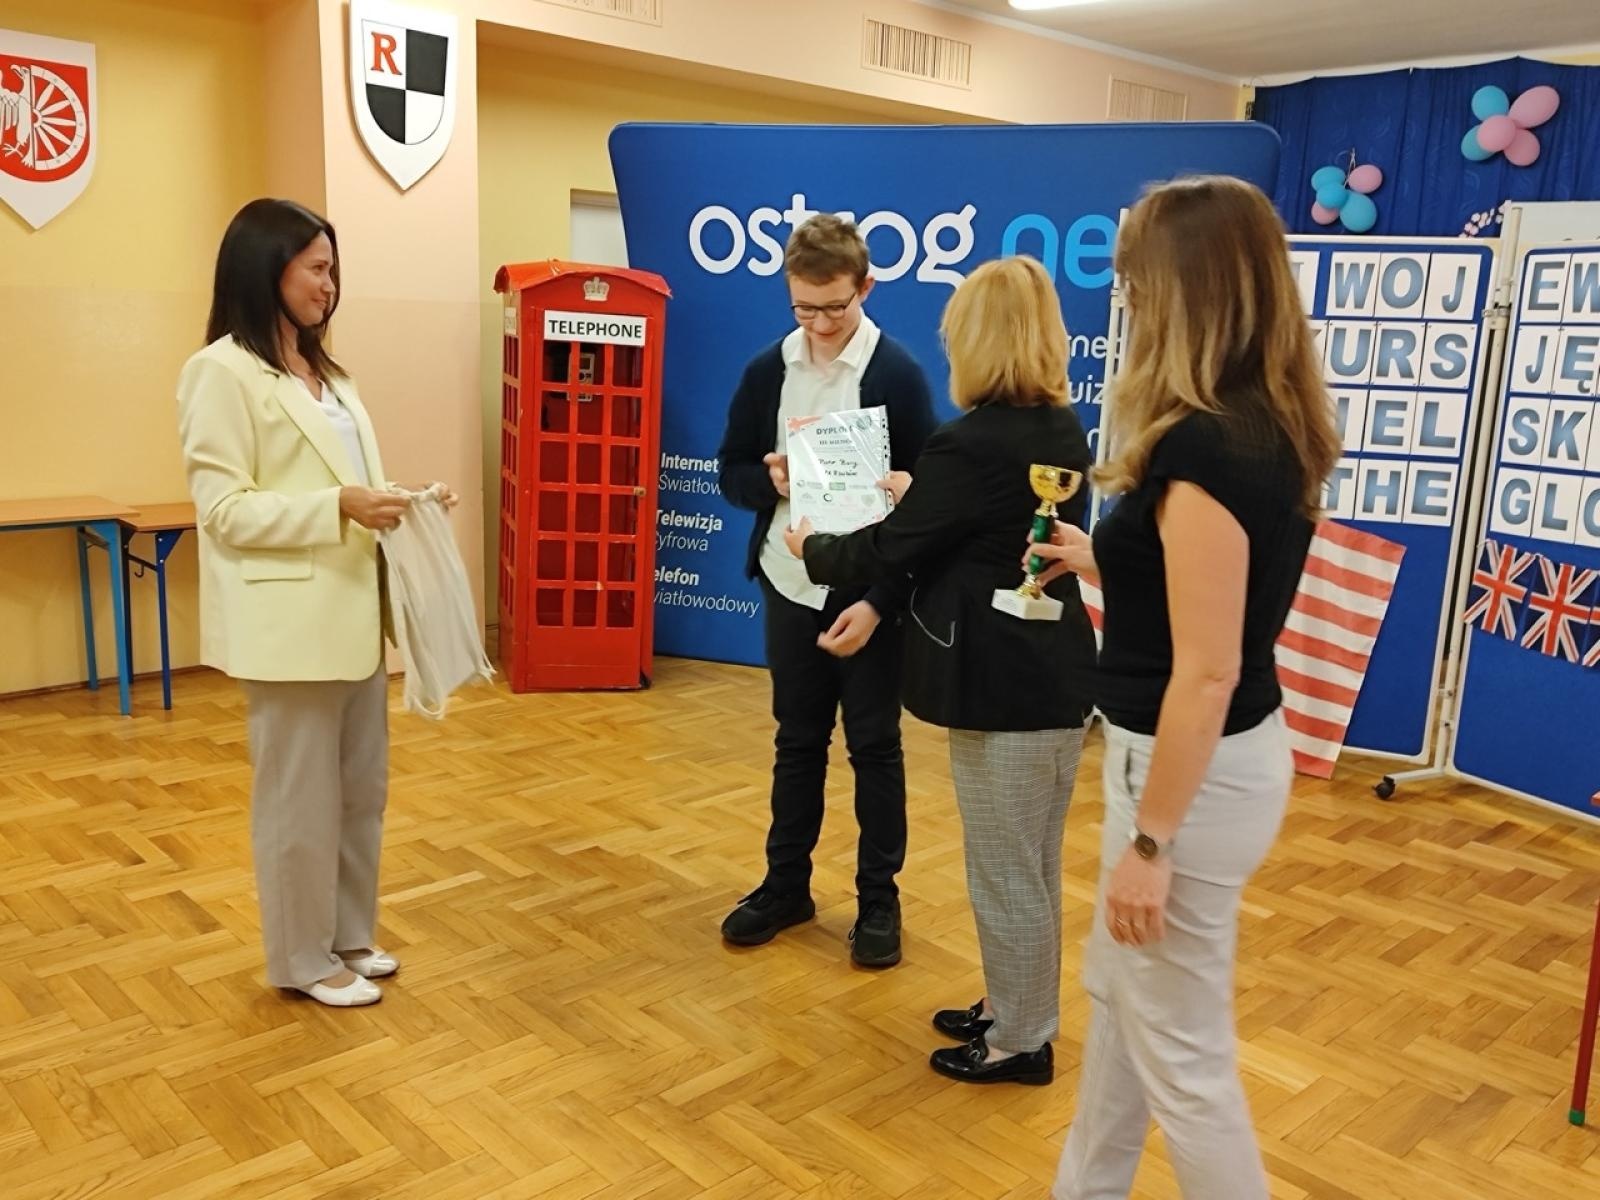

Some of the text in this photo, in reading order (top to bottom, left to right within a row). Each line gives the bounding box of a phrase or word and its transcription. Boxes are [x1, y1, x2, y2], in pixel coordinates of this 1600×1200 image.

[370, 31, 403, 76] R
[548, 319, 642, 339] TELEPHONE
[1313, 327, 1468, 380] URS
[660, 452, 720, 473] Internet
[1325, 466, 1453, 516] THE
[655, 509, 724, 535] Telewizja
